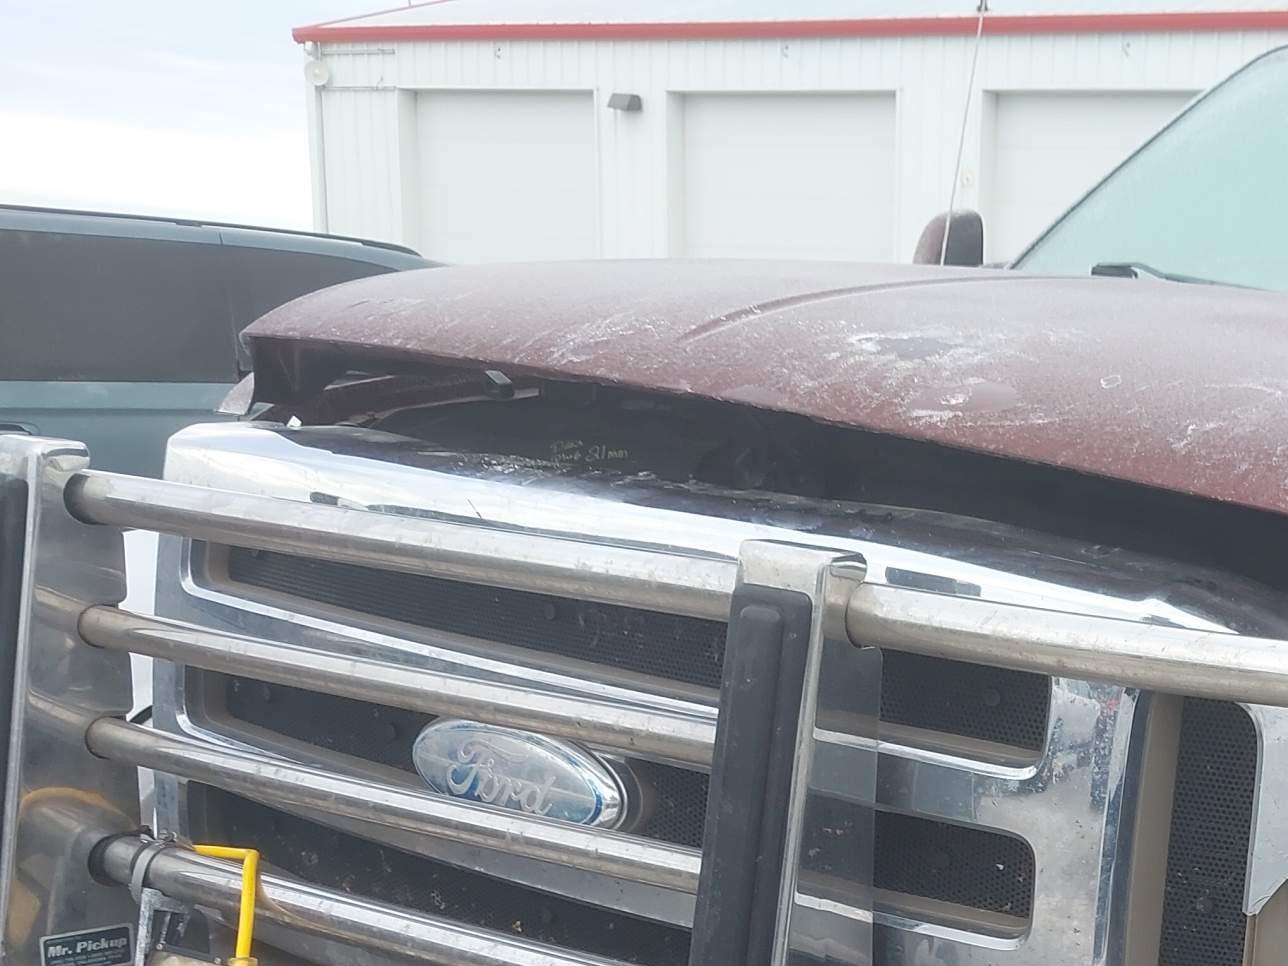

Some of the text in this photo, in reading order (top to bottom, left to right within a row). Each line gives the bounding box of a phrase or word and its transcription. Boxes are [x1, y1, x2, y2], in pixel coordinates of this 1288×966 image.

[446, 739, 557, 816] Ford
[47, 945, 73, 959] Mr.
[76, 937, 127, 953] Pickup
